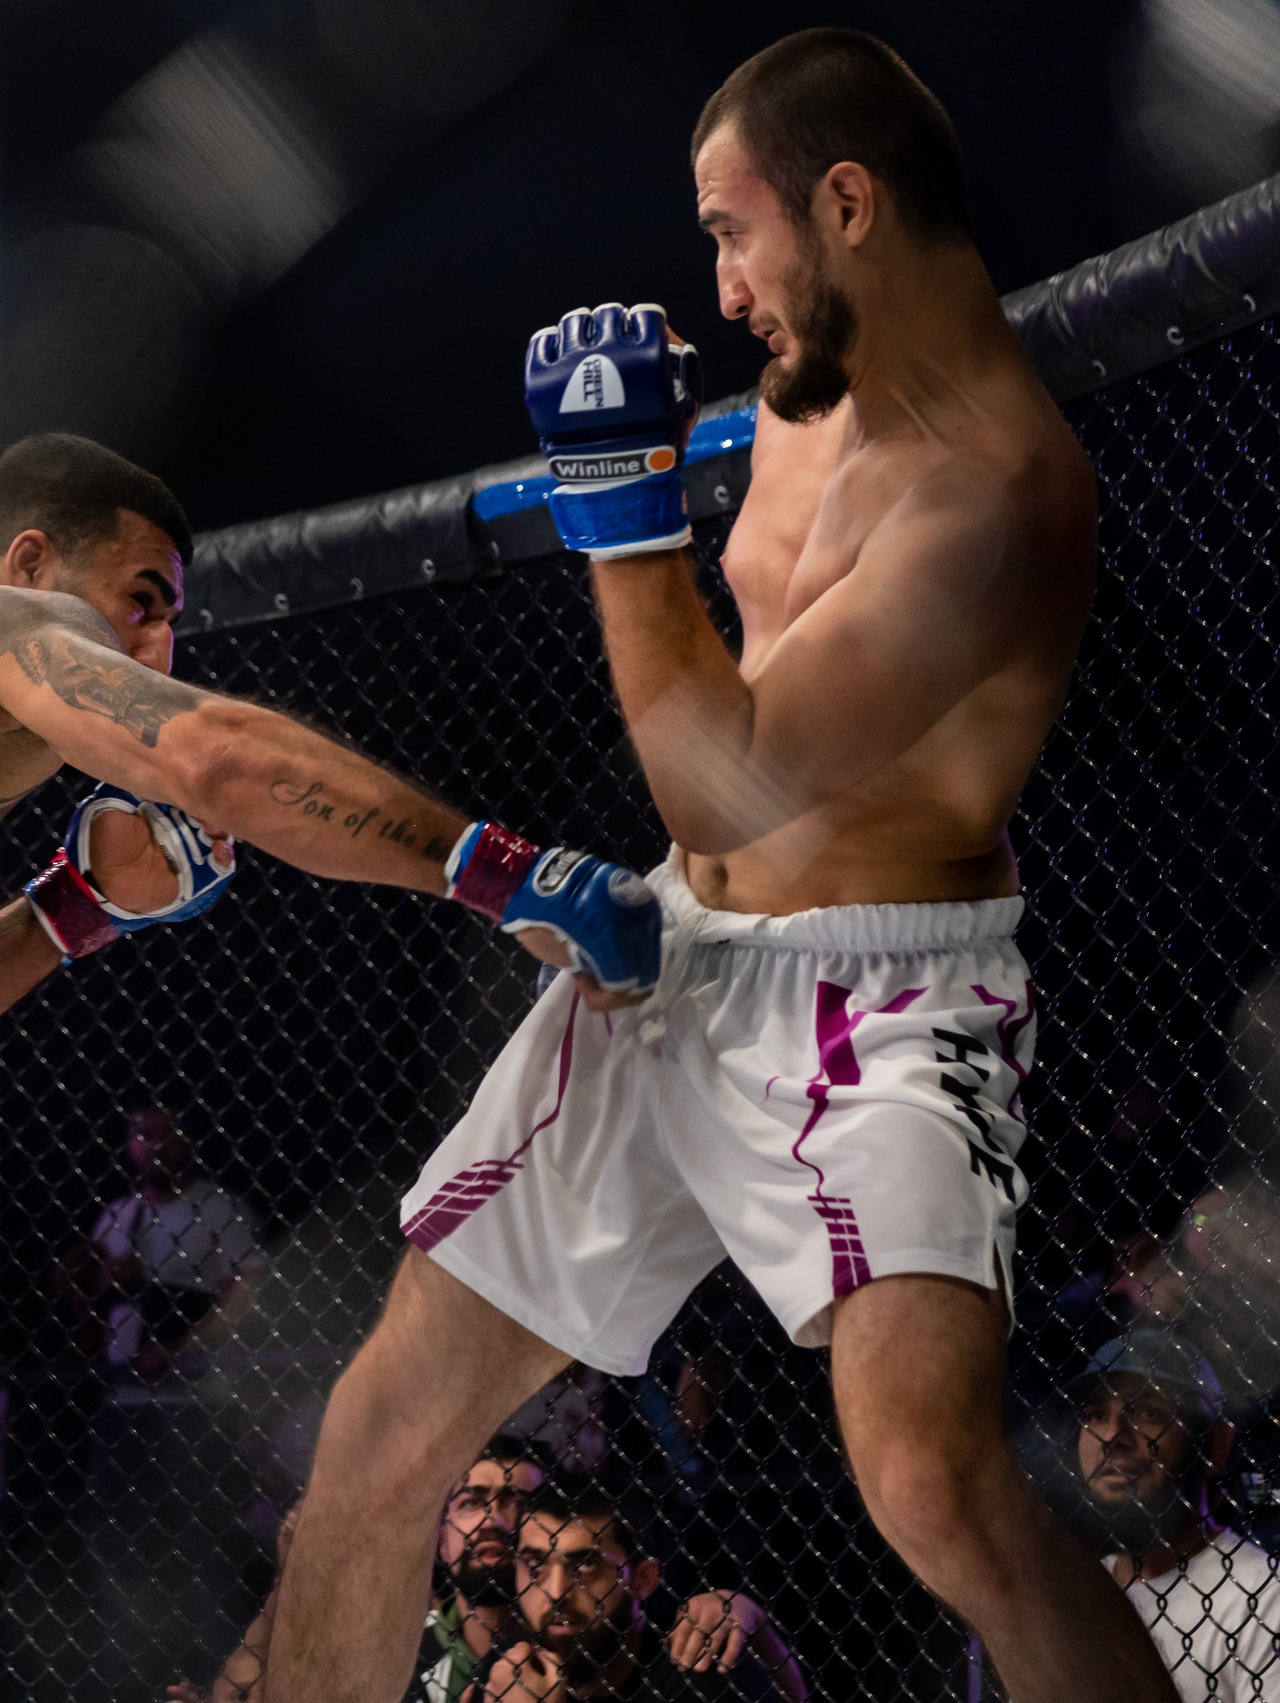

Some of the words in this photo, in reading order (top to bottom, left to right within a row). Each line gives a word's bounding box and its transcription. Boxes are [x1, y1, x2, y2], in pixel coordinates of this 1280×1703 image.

[583, 361, 595, 403] HILL
[555, 460, 641, 478] Winline
[270, 779, 335, 821] Son
[344, 807, 380, 839] of
